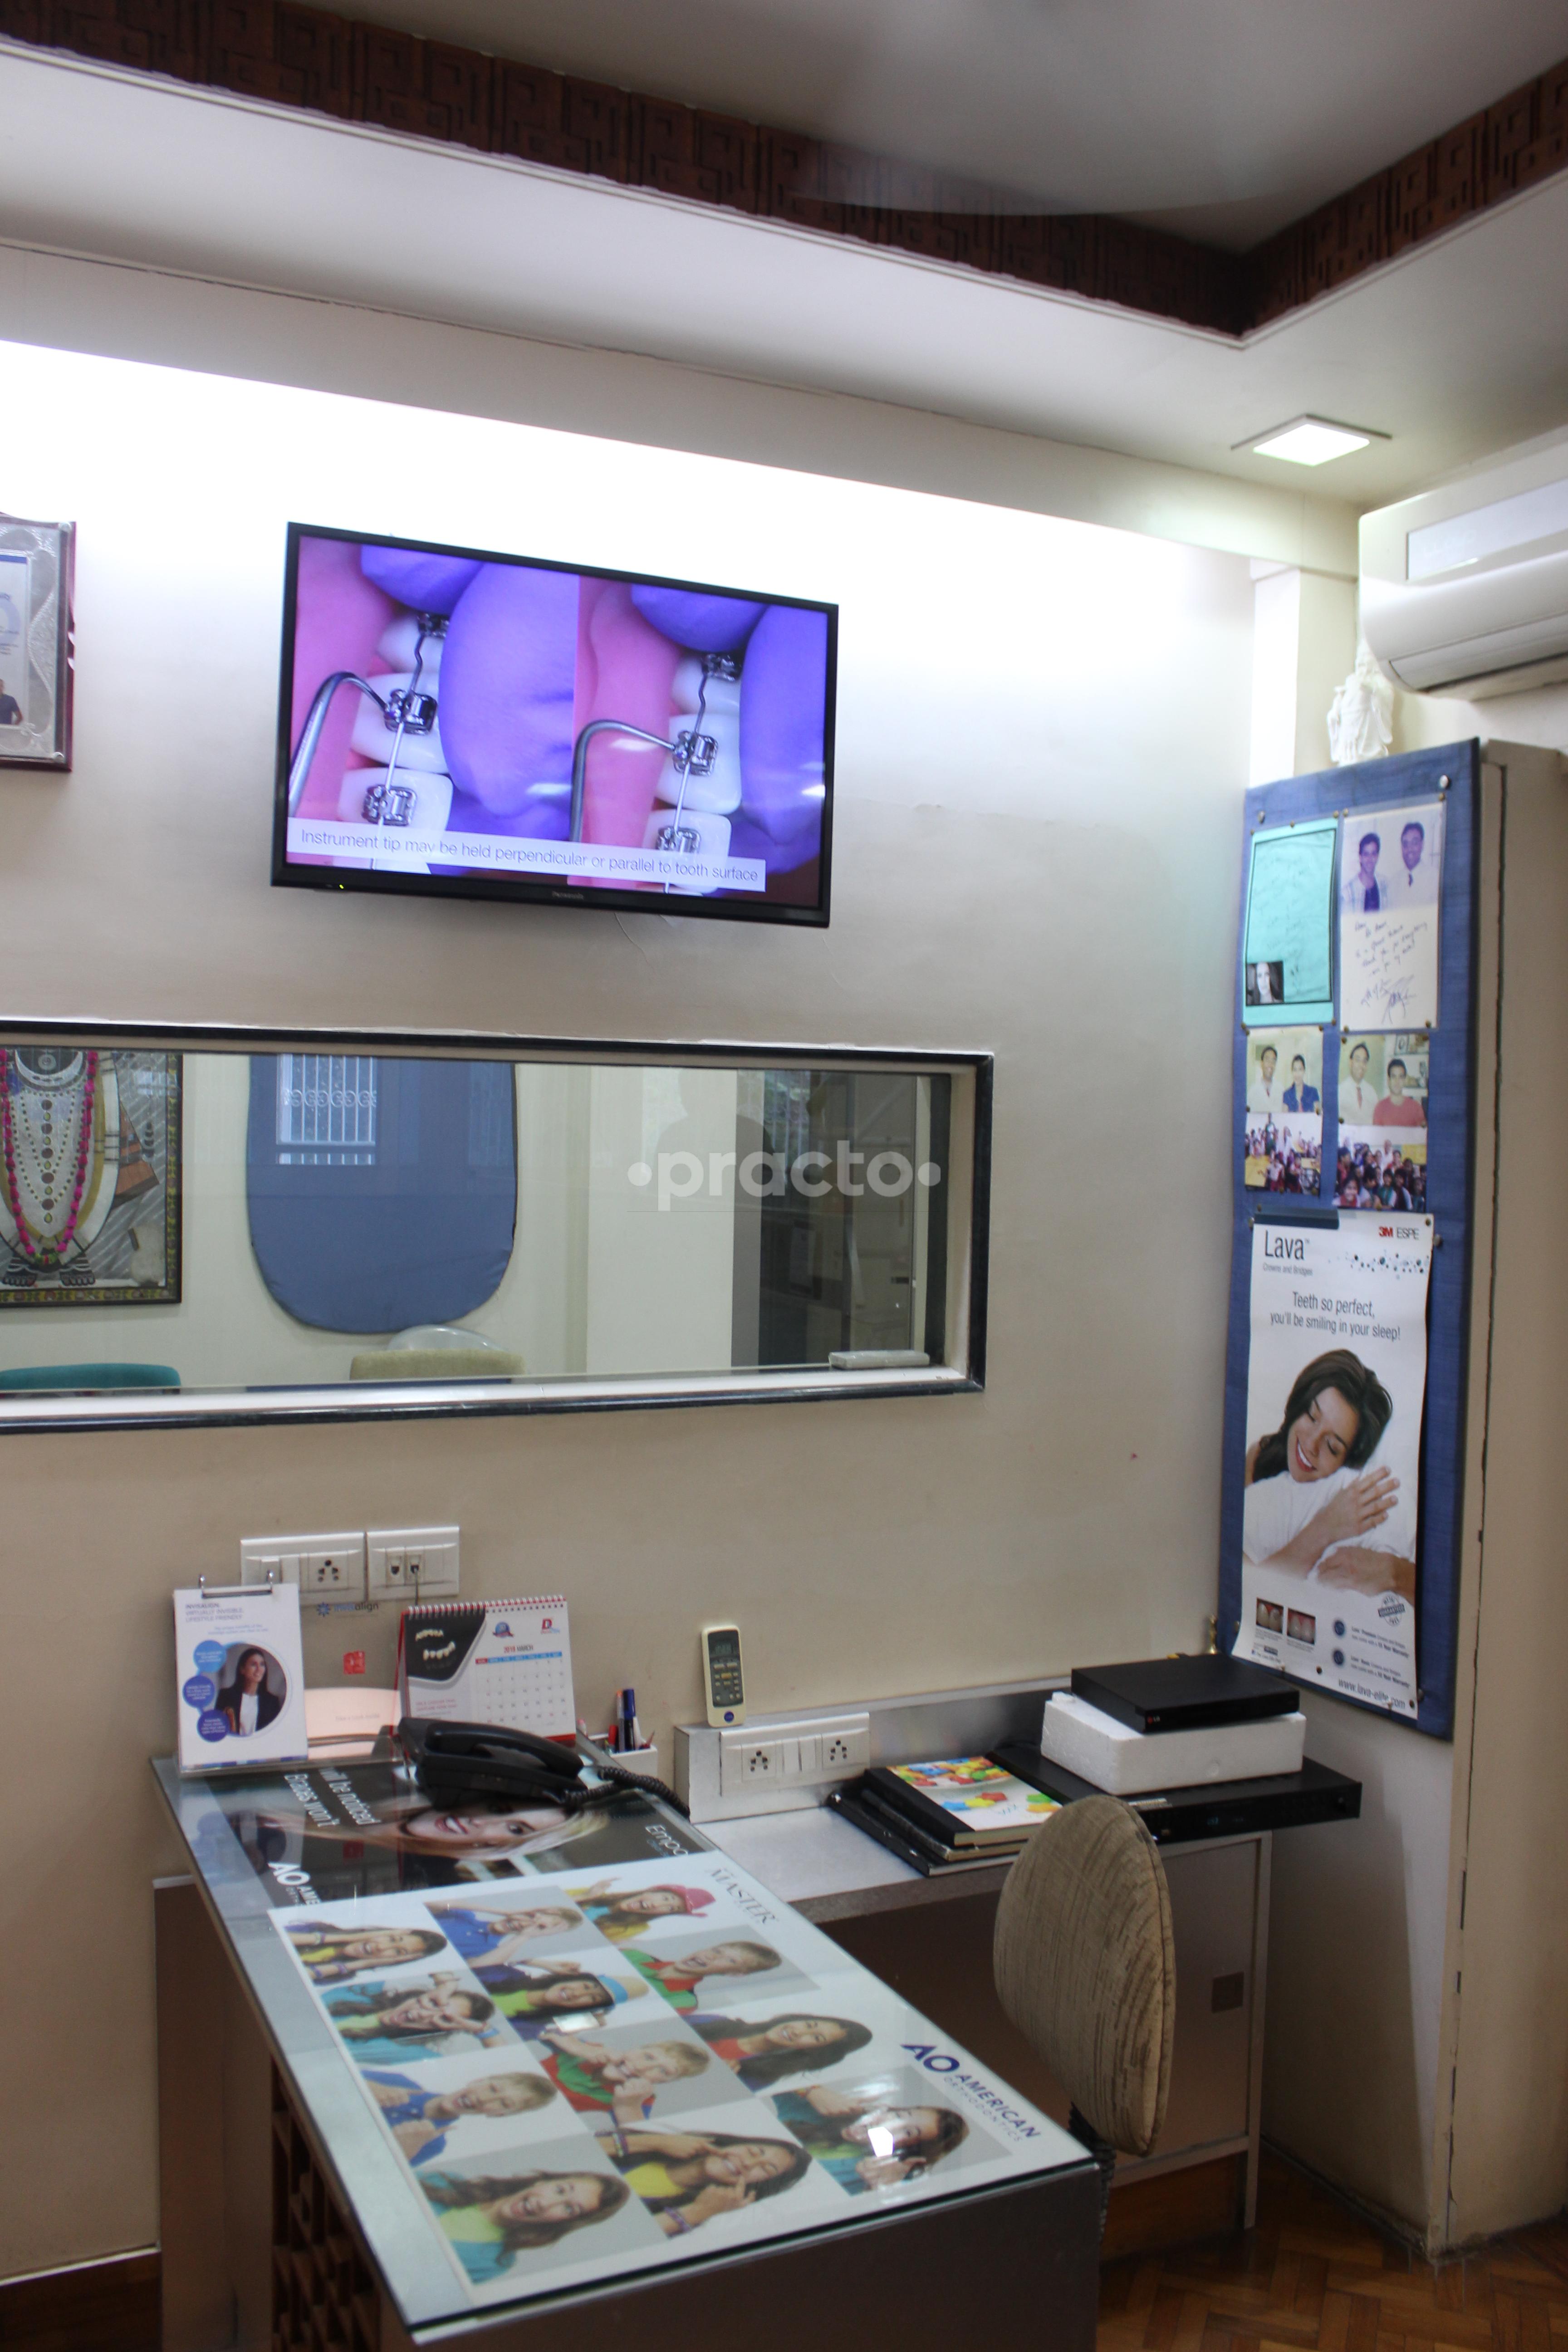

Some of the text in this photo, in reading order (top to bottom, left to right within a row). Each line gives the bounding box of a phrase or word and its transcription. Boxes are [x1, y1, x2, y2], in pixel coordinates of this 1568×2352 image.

[301, 829, 758, 882] Instrument tip may be held perpendicular or parallel to tooth surface
[1379, 1226, 1420, 1240] 3M ESPE
[1293, 1291, 1375, 1319] Teeth so perfect,
[1270, 1312, 1401, 1342] you'll be smiling in your sleep!
[284, 1773, 340, 1828] Braces won't
[337, 1792, 383, 1826] noticed
[900, 2043, 1043, 2139] AO AMERICAN
